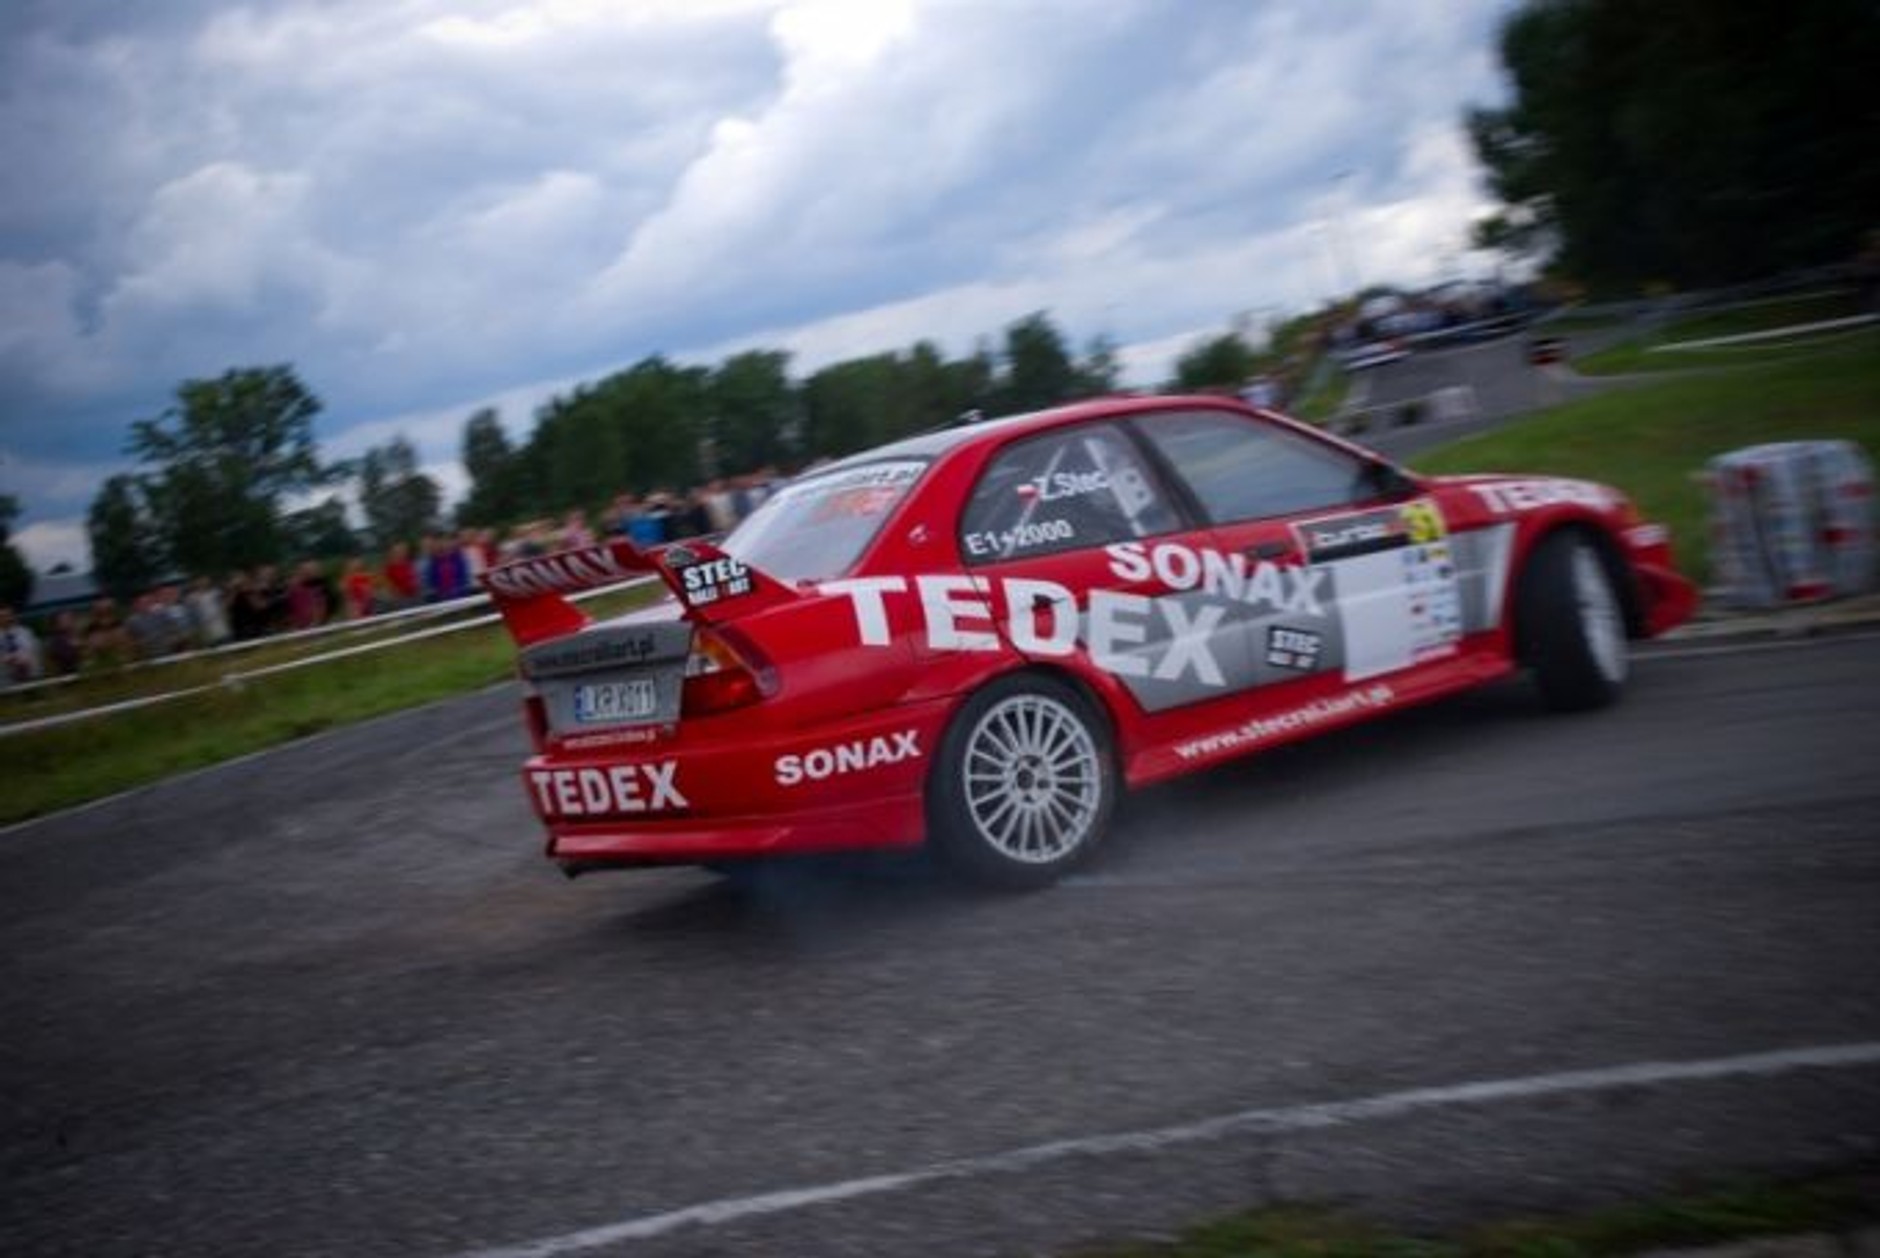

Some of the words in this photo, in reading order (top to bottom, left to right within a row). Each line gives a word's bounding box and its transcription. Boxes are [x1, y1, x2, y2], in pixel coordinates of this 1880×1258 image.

[488, 547, 616, 595] SONAX
[682, 560, 747, 591] STEC
[1105, 541, 1324, 616] SONAX
[819, 574, 1226, 687] TEDEX
[775, 729, 921, 786] SONAX
[530, 761, 689, 816] TEDEX
